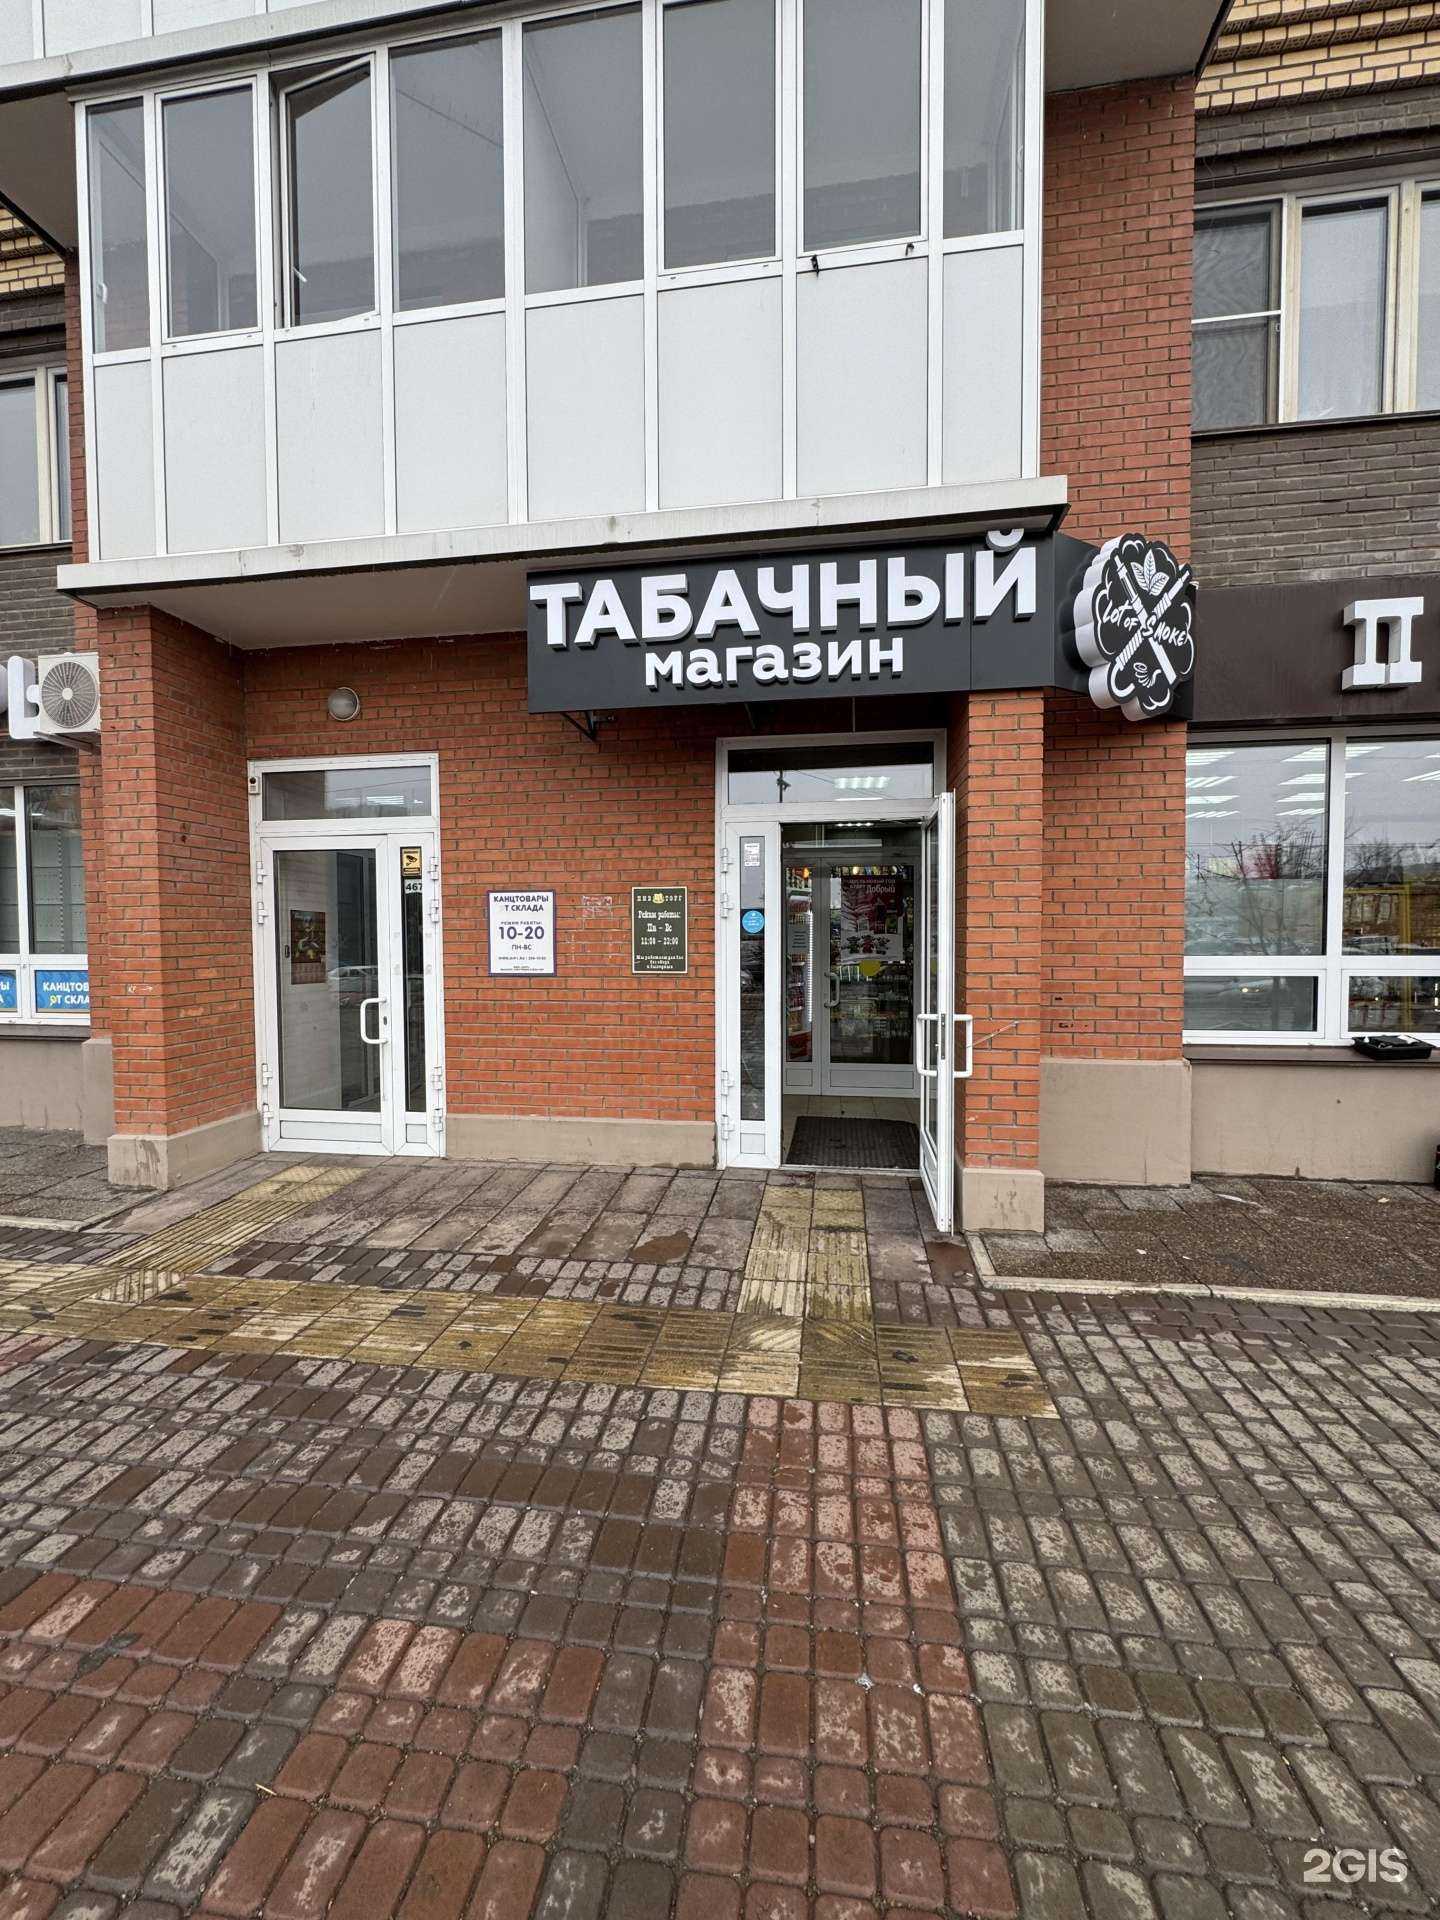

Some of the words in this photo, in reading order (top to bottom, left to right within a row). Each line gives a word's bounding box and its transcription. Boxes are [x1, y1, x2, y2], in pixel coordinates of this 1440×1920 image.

[530, 529, 1038, 648] ТАБАЧНЫЙ
[1102, 599, 1133, 627] LOT
[1123, 617, 1139, 631] OF
[1142, 614, 1187, 647] SMOKE
[645, 636, 904, 689] магазин
[493, 895, 549, 903] КАНЦТОВАРЫ
[511, 904, 544, 912] СКЛАДА
[499, 926, 545, 940] 10-20
